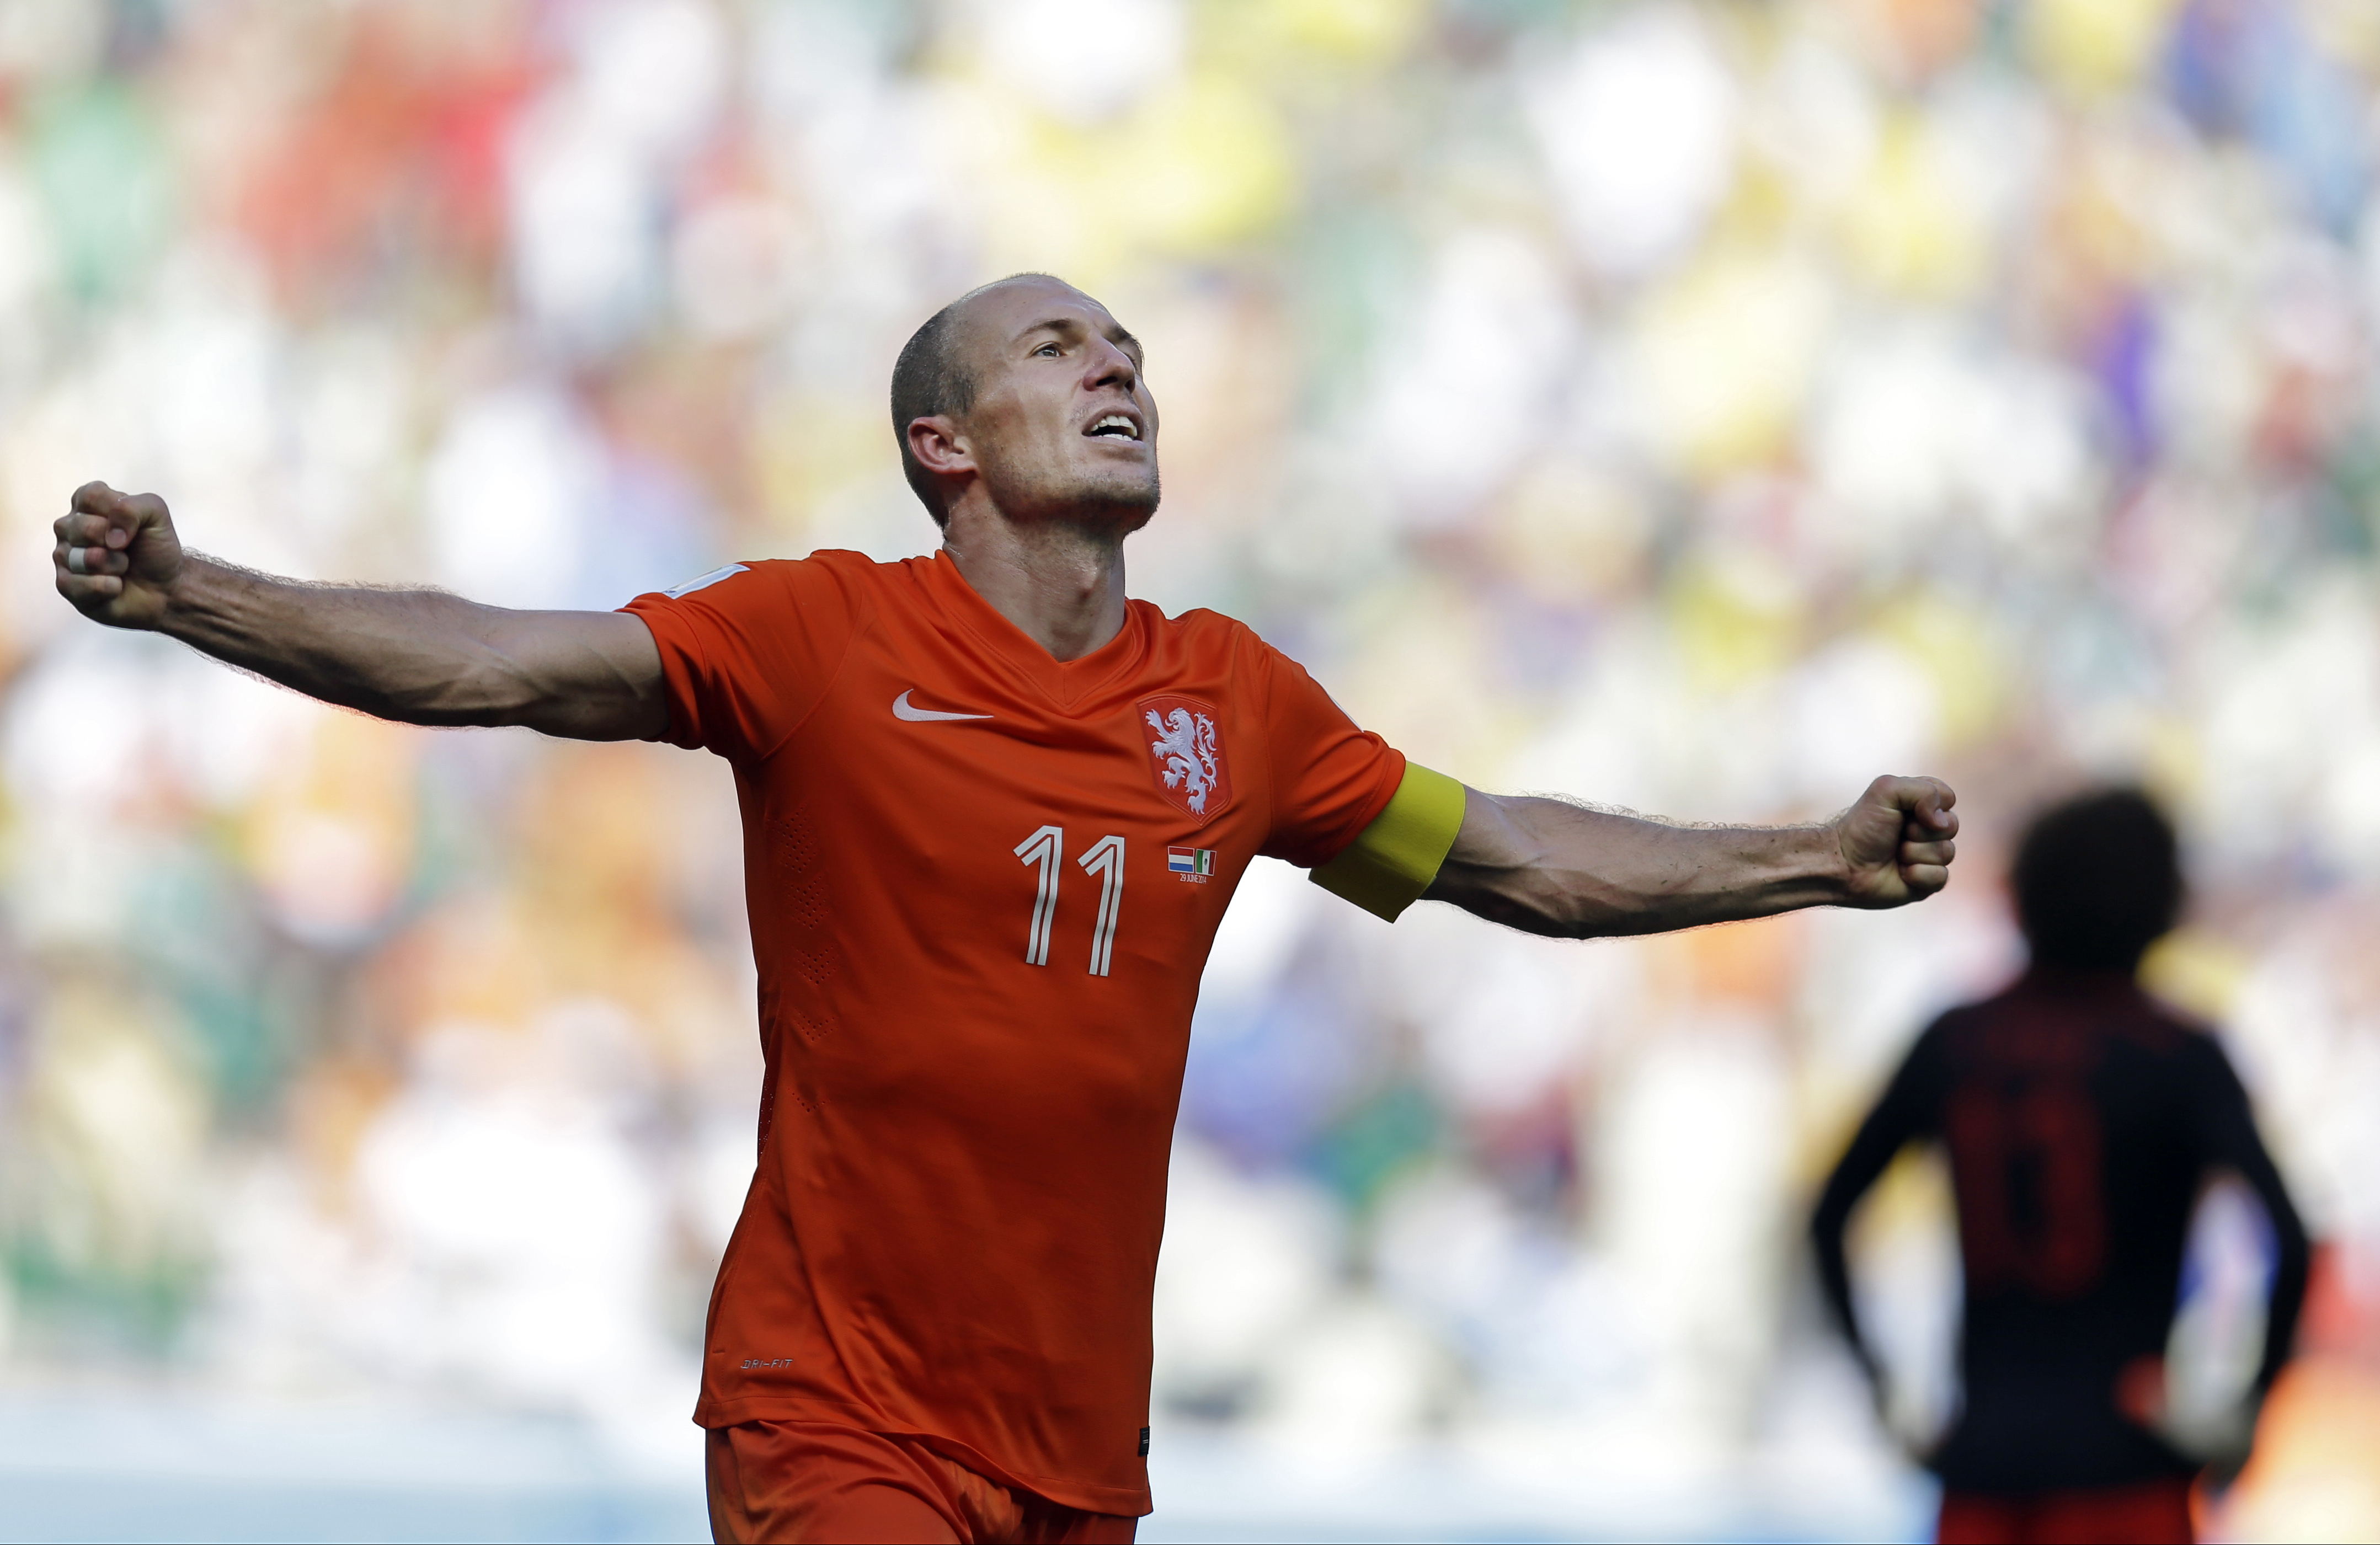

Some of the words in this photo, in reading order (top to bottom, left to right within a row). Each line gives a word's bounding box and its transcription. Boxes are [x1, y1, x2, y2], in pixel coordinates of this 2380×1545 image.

[1180, 873, 1186, 882] 29
[1187, 874, 1198, 883] JUNE
[1198, 875, 1207, 884] 2014
[1013, 825, 1125, 977] 11
[740, 1359, 793, 1369] DRI-FIT
